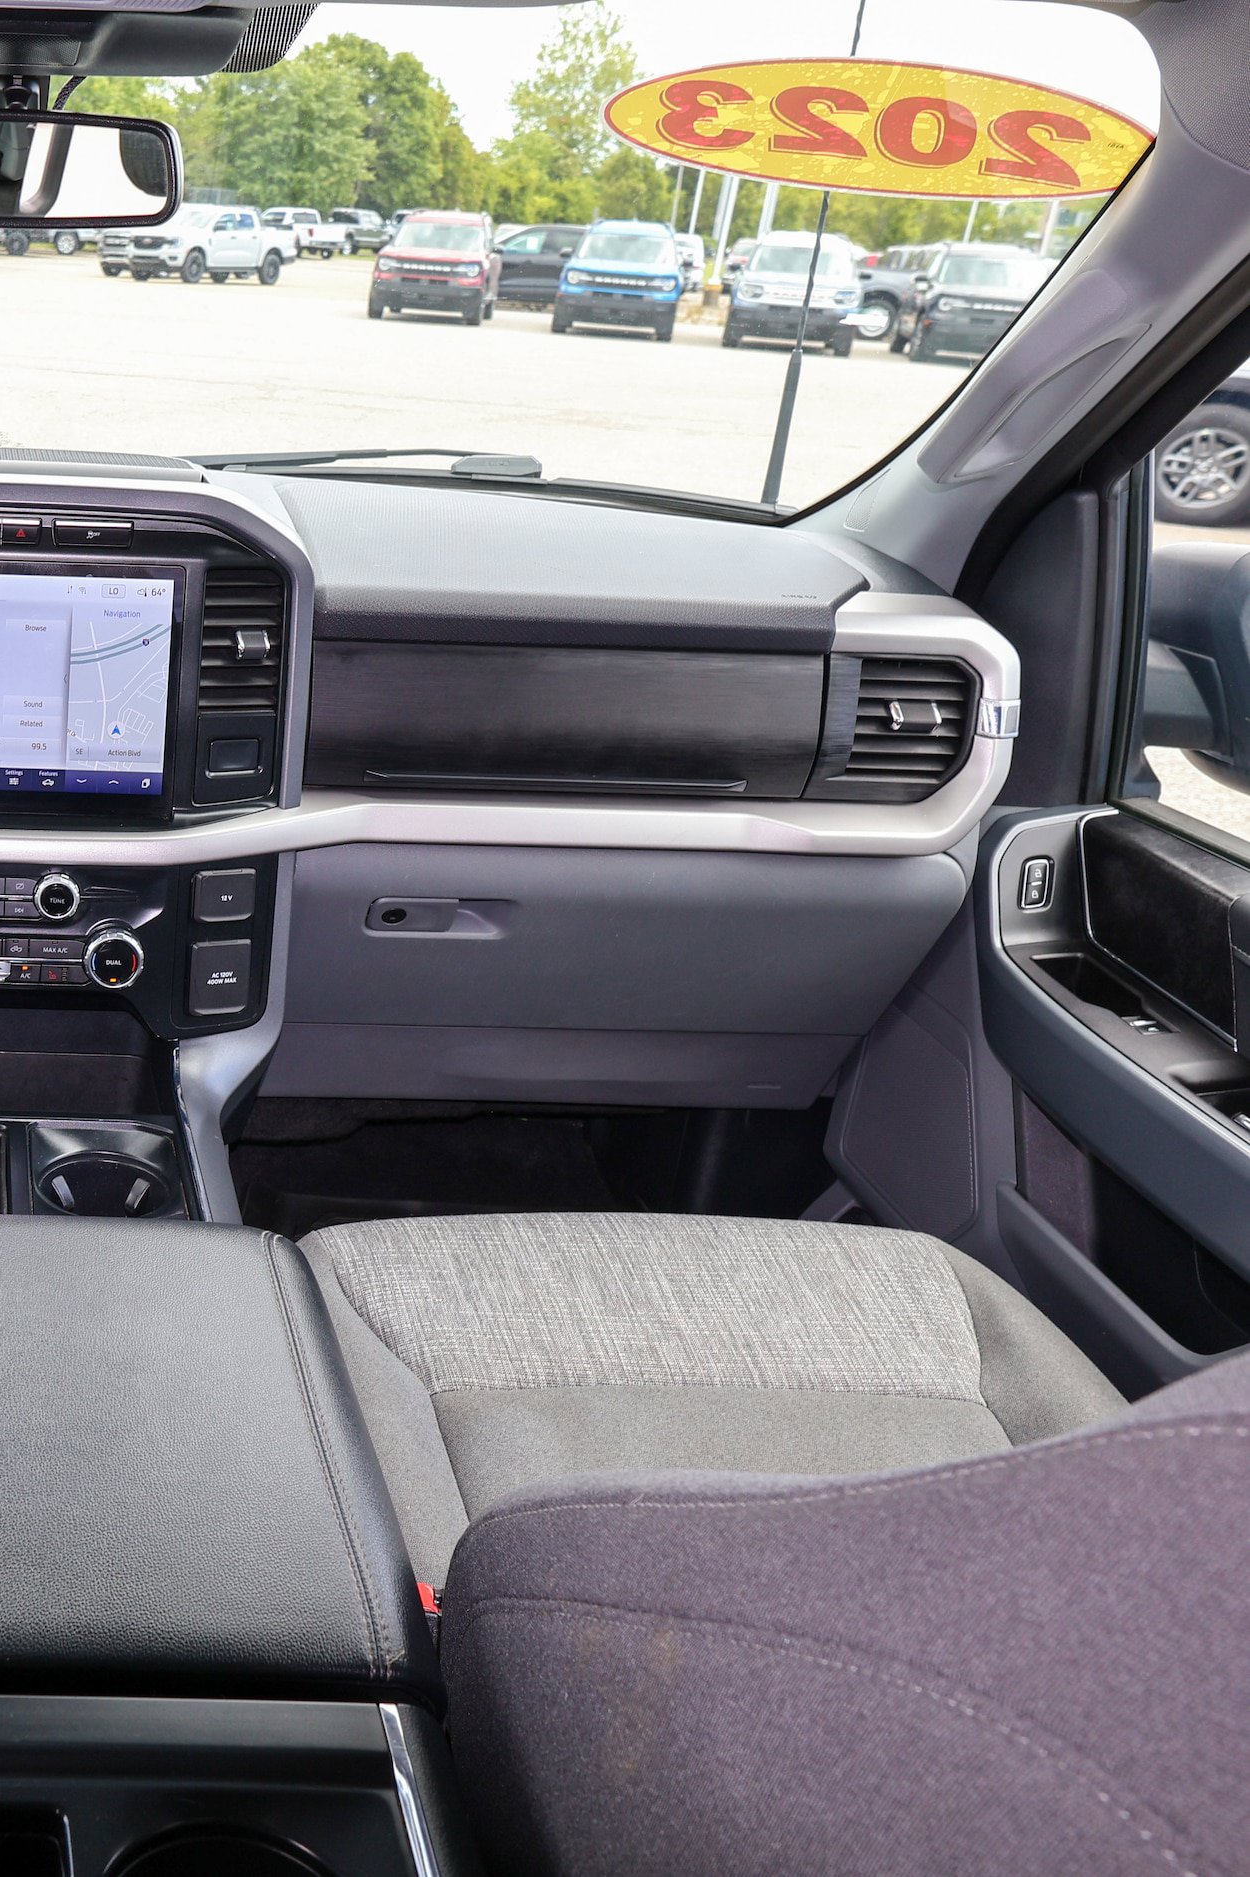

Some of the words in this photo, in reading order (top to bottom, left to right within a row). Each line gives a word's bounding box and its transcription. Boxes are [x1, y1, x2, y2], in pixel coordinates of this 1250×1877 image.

[108, 587, 119, 595] LO
[104, 608, 141, 618] Navigation
[25, 624, 47, 632] Browse
[23, 700, 43, 708] Sound
[19, 719, 43, 727] Related
[31, 742, 47, 750] 99.5
[128, 749, 141, 757] Blvd
[5, 769, 24, 777] Settings
